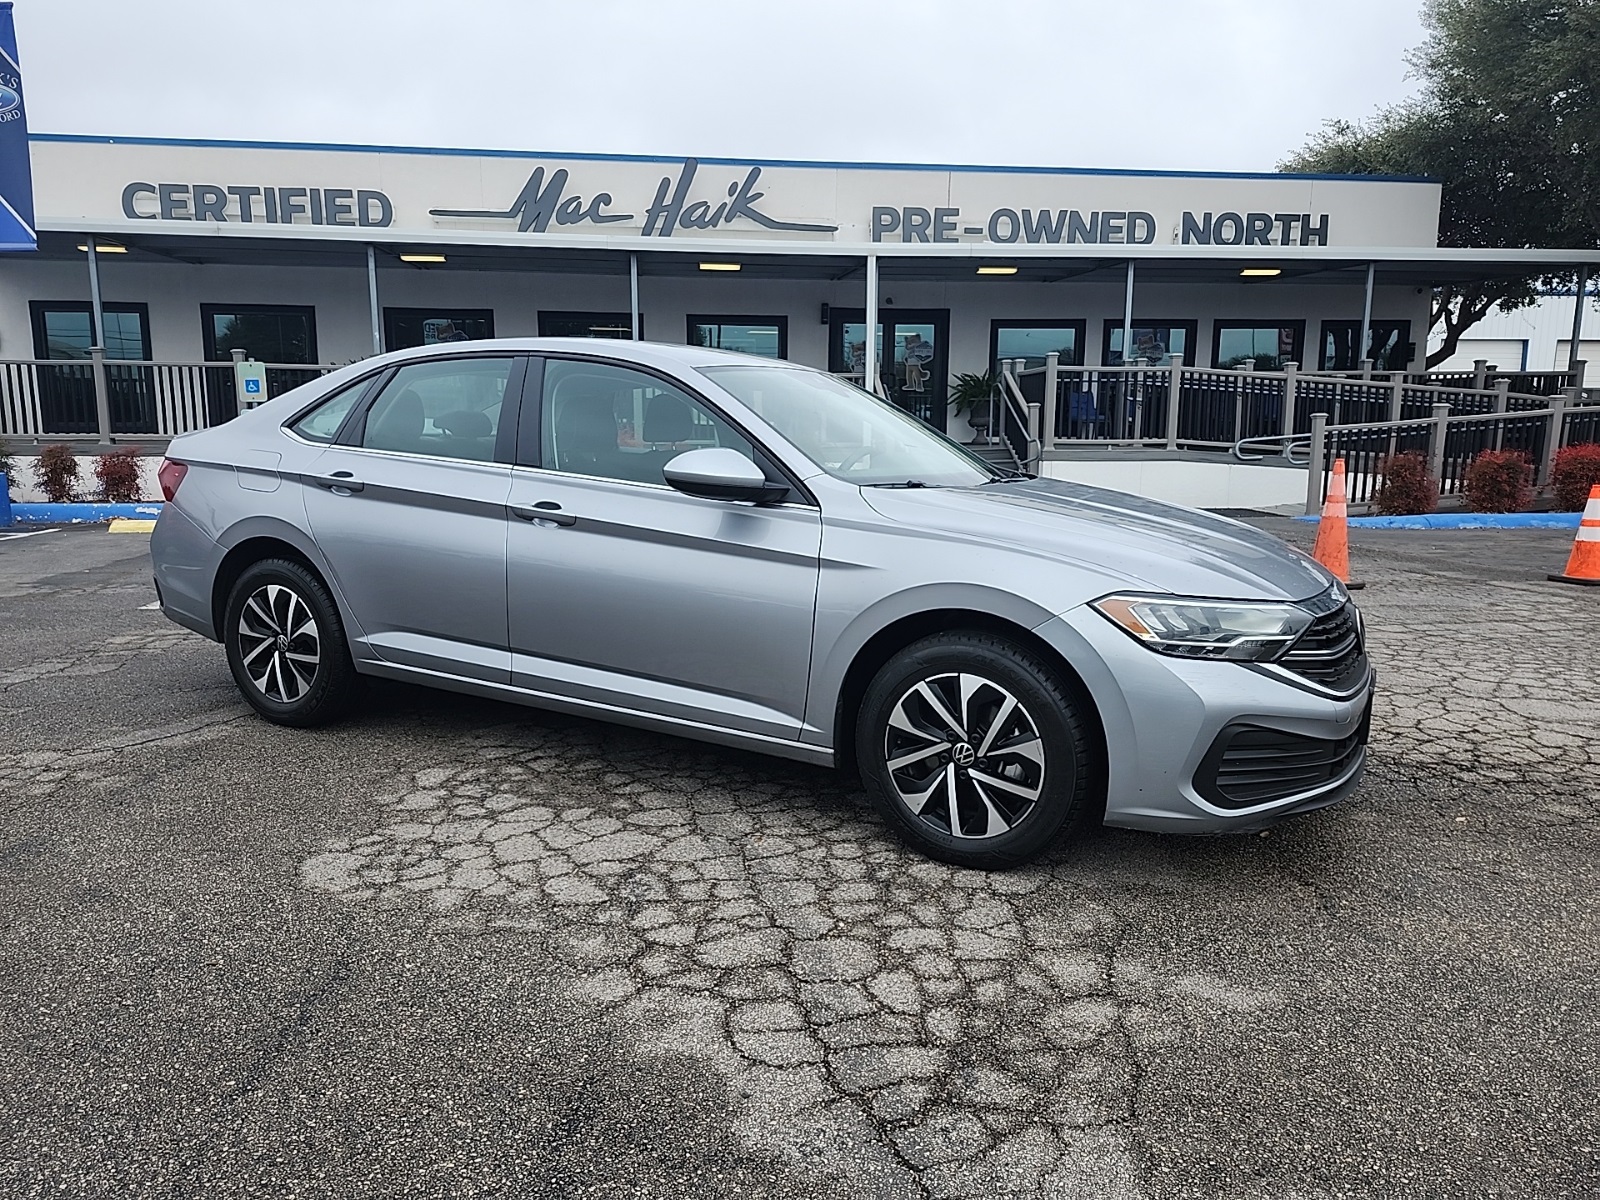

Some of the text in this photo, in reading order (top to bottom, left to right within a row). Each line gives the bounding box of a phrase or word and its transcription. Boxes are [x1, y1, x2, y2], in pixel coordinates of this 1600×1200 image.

[122, 157, 1329, 246] CERTIFIED Mac Haik PRE-OWNED NORTH
